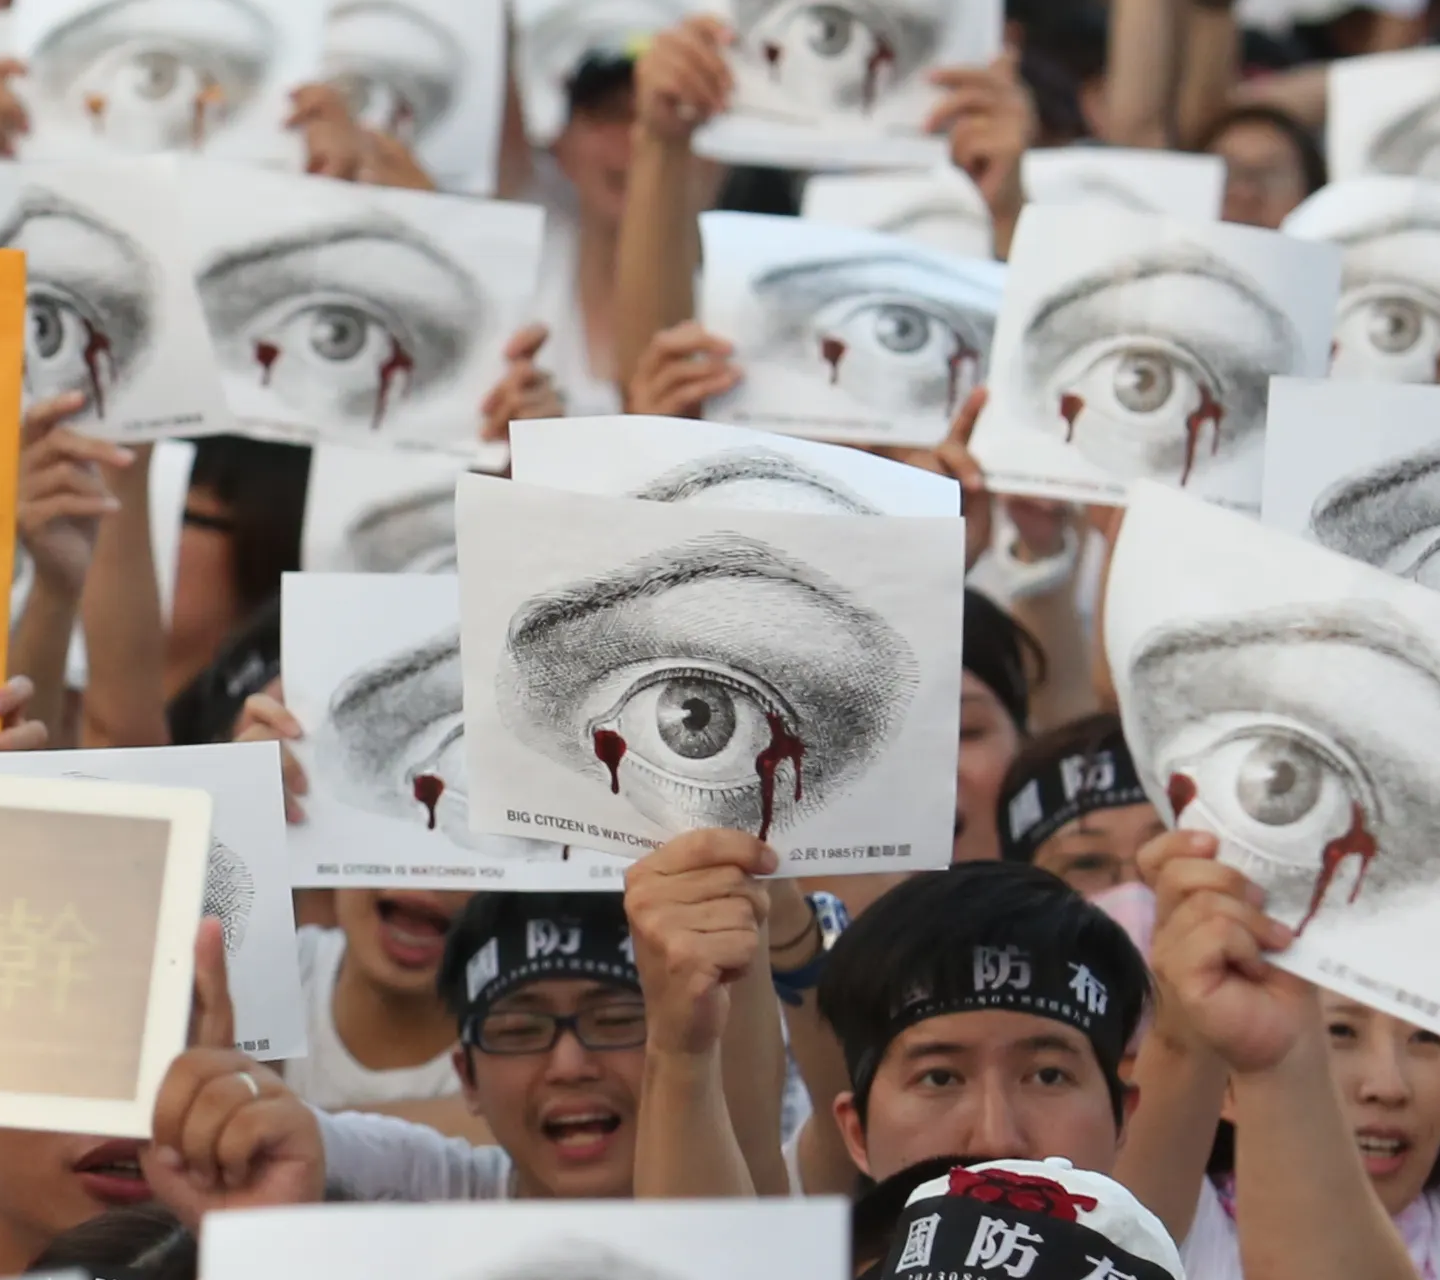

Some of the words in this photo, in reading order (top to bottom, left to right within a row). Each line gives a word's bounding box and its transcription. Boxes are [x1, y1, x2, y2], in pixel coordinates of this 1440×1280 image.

[507, 810, 531, 824] BIG
[534, 814, 585, 834] CITIZEN
[588, 824, 600, 837] IS
[789, 843, 911, 861] 公民1985行動聯盟
